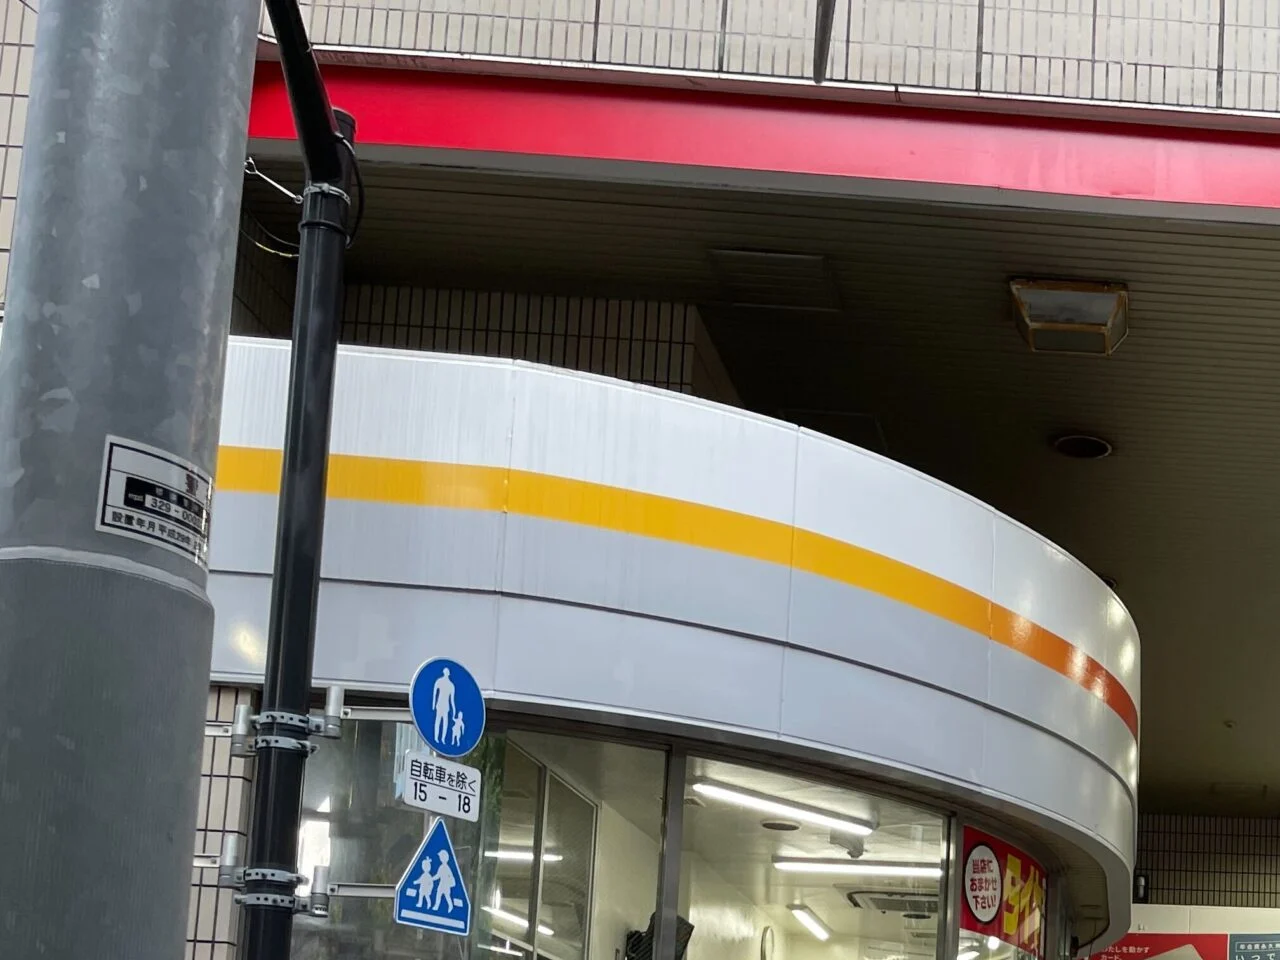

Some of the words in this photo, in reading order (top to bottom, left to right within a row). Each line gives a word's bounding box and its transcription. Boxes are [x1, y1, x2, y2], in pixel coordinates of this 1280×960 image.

[411, 758, 477, 793] 自転車を除く
[414, 781, 427, 802] 15
[458, 793, 471, 814] 18
[969, 877, 998, 893] おまかせ
